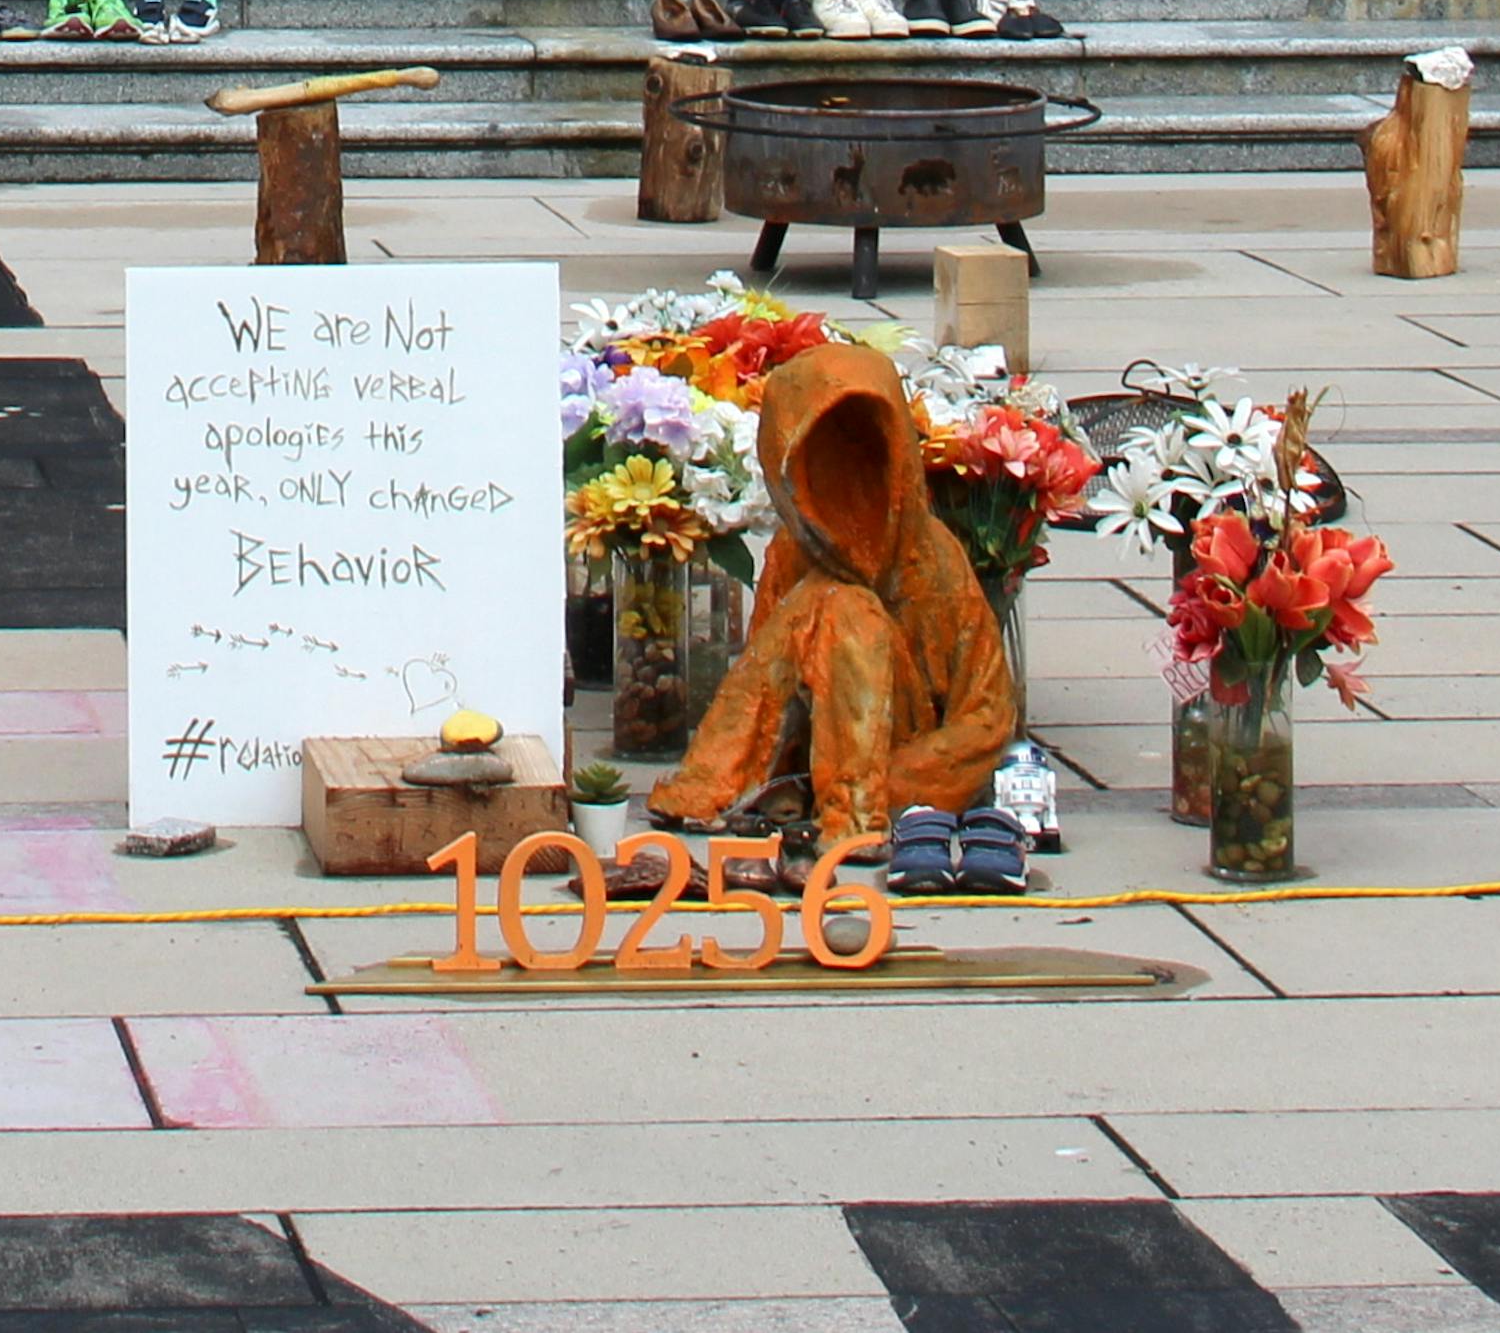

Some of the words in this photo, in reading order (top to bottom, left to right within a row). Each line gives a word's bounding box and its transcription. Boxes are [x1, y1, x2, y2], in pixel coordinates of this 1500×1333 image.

[217, 296, 290, 353] WE
[313, 310, 371, 348] are
[385, 297, 454, 354] Not
[363, 421, 424, 455] this
[279, 468, 353, 507] ONLY
[425, 830, 894, 971] 10256
